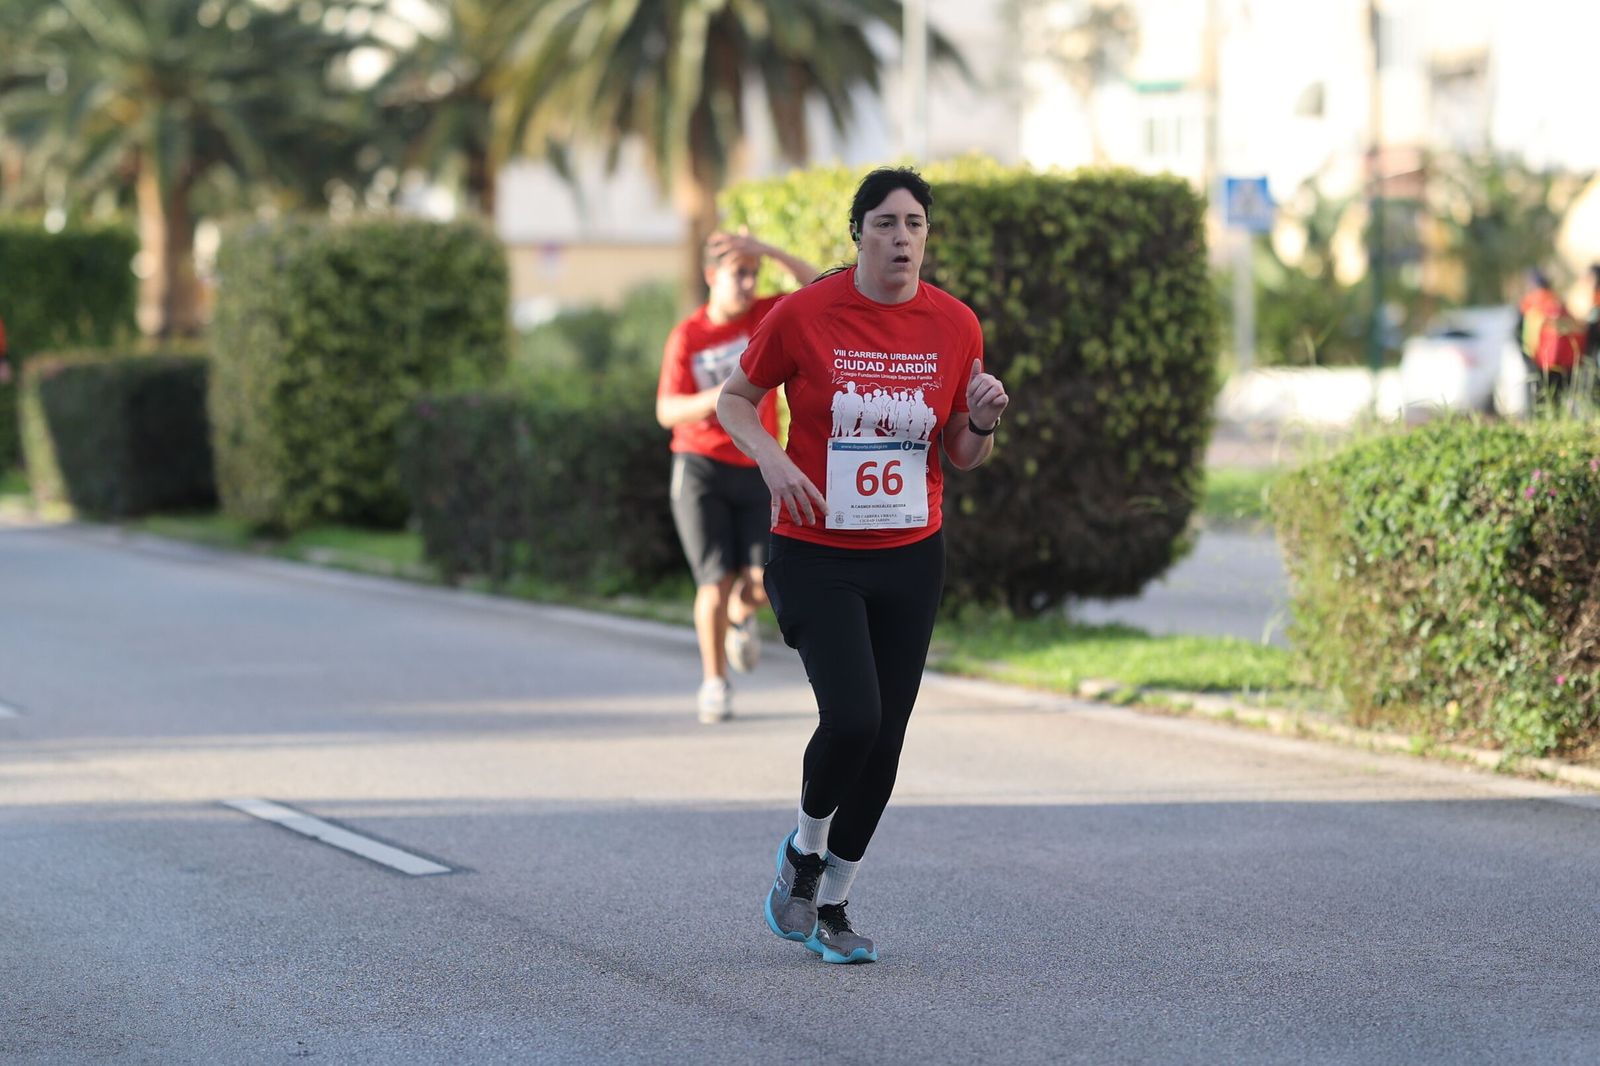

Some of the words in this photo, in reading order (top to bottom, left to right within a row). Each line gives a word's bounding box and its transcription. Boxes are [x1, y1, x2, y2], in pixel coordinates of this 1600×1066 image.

[833, 348, 846, 357] VIII
[848, 350, 889, 360] CARRERA
[890, 352, 925, 361] URBANA
[926, 352, 938, 360] DE
[834, 358, 885, 372] CIUDAD
[888, 360, 937, 374] JARDÍN
[856, 459, 904, 497] 66
